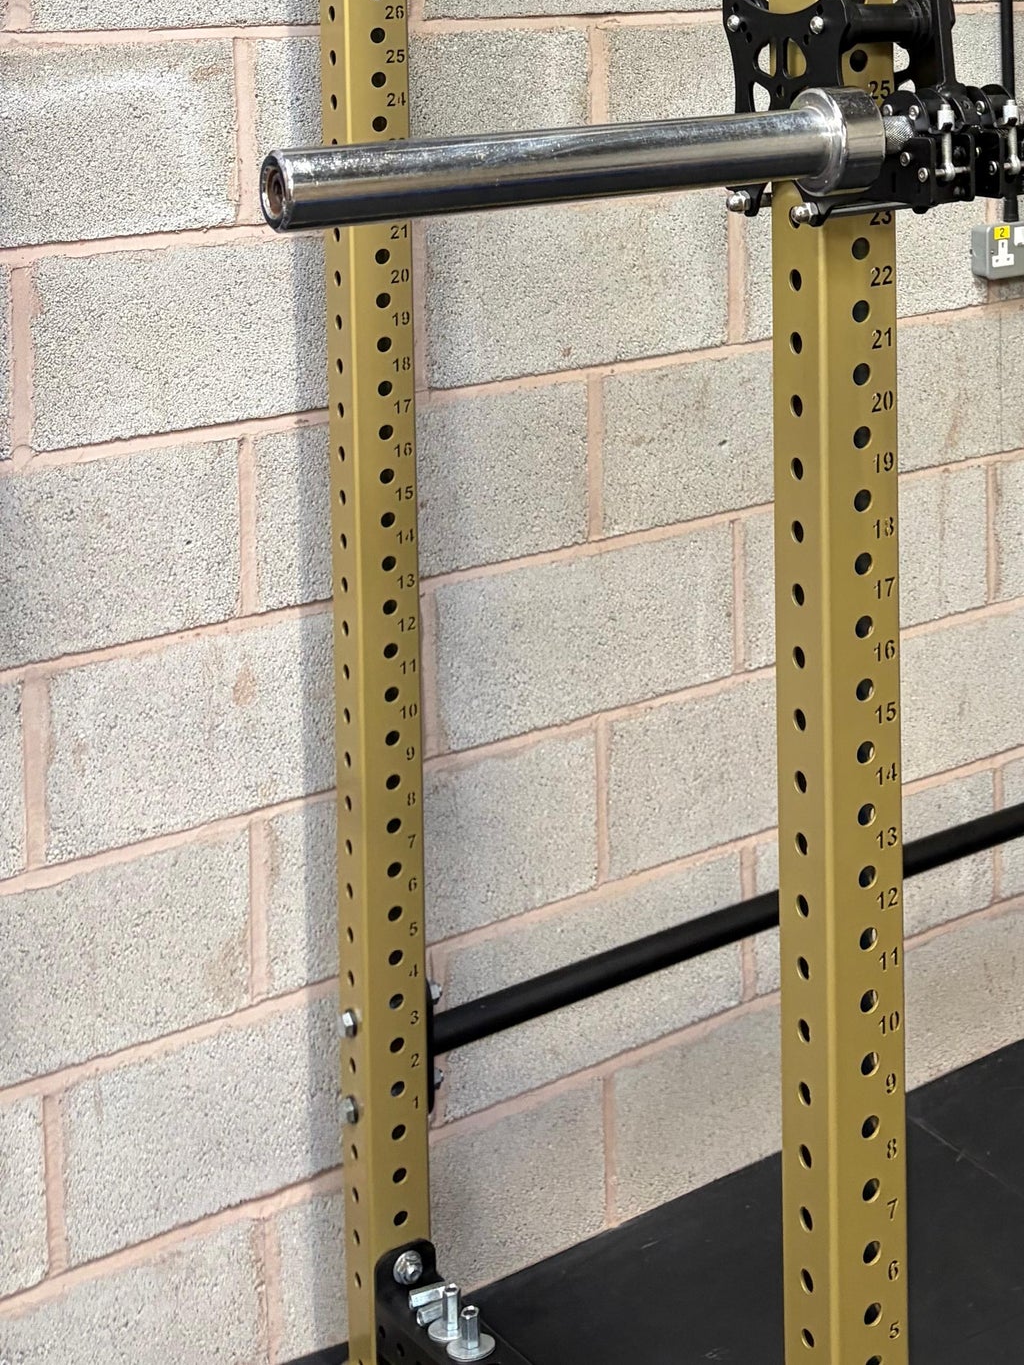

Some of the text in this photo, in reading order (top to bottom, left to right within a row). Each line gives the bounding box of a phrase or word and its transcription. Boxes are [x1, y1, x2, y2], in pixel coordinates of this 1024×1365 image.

[385, 6, 404, 20] 26
[386, 50, 404, 64] 25
[869, 80, 890, 99] 25
[387, 92, 406, 106] 24
[390, 224, 408, 239] 21
[1000, 228, 1005, 237] 2
[390, 268, 409, 284] 20
[870, 266, 893, 287] 22
[392, 312, 410, 326] 19
[872, 328, 892, 349] 21
[392, 356, 410, 372] 18
[394, 399, 412, 414] 17
[872, 390, 893, 413] 20
[394, 442, 412, 458] 16
[873, 452, 894, 473] 19
[396, 486, 414, 502] 15
[873, 517, 894, 538] 18
[396, 528, 414, 544] 14
[397, 574, 415, 589] 13
[874, 577, 895, 599] 17
[398, 616, 416, 632] 12
[874, 640, 895, 662] 16
[400, 659, 416, 674] 11
[400, 704, 418, 719] 10
[874, 702, 896, 724] 15
[406, 746, 414, 760] 9
[876, 762, 898, 786] 14
[407, 792, 416, 806] 8
[408, 834, 416, 849] 7
[876, 827, 897, 849] 13
[408, 878, 417, 892] 6
[877, 888, 898, 910] 12
[409, 922, 418, 936] 5
[879, 947, 898, 970] 11
[409, 964, 419, 978] 4
[410, 1010, 419, 1025] 3
[879, 1011, 900, 1035] 10
[411, 1053, 419, 1068] 2
[886, 1074, 896, 1094] 9
[412, 1095, 419, 1110] 1
[887, 1139, 897, 1159] 8
[888, 1198, 898, 1220] 7
[888, 1260, 899, 1281] 6
[889, 1322, 900, 1339] 5
